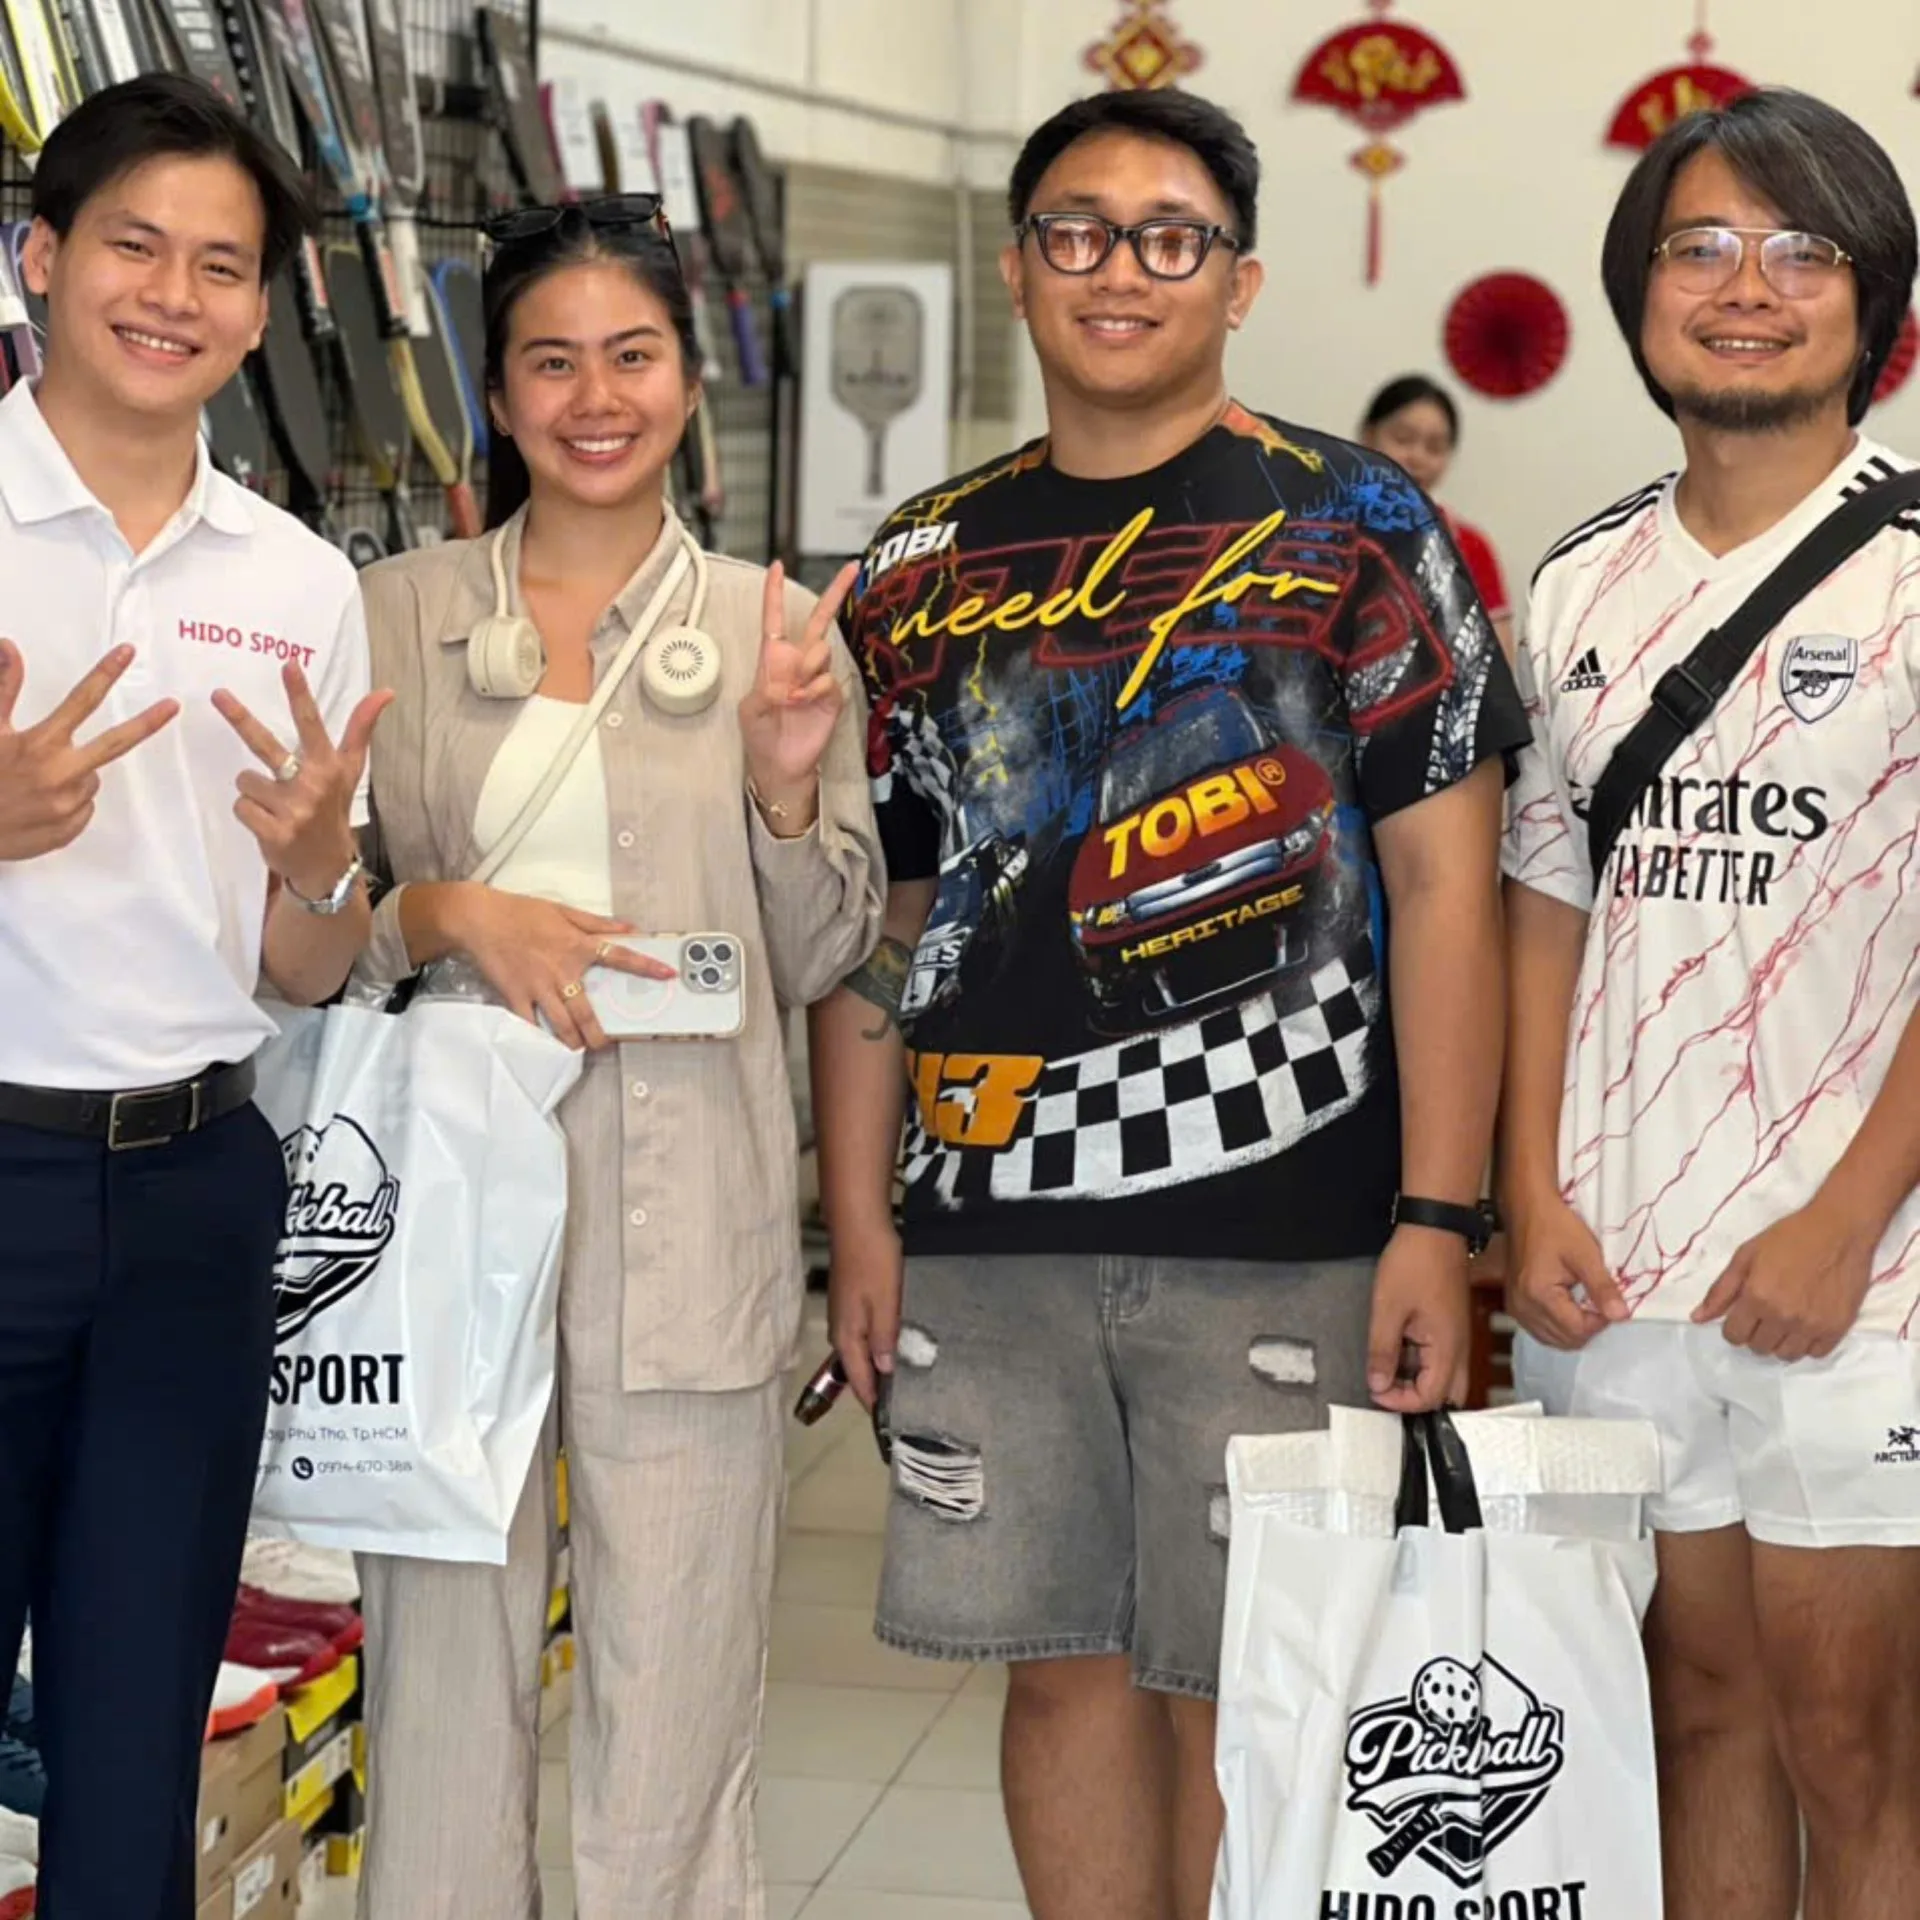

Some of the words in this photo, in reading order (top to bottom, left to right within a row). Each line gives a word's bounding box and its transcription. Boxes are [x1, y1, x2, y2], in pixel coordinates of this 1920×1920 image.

[891, 506, 1156, 645] need
[1116, 509, 1340, 709] for
[178, 618, 242, 648] HIDO
[249, 631, 316, 668] SPORT
[1793, 645, 1847, 661] Arsenal
[1560, 673, 1607, 692] adidas
[1620, 770, 1829, 842] irates
[1119, 884, 1305, 963] HERITAGE
[268, 1354, 404, 1405] SPORT
